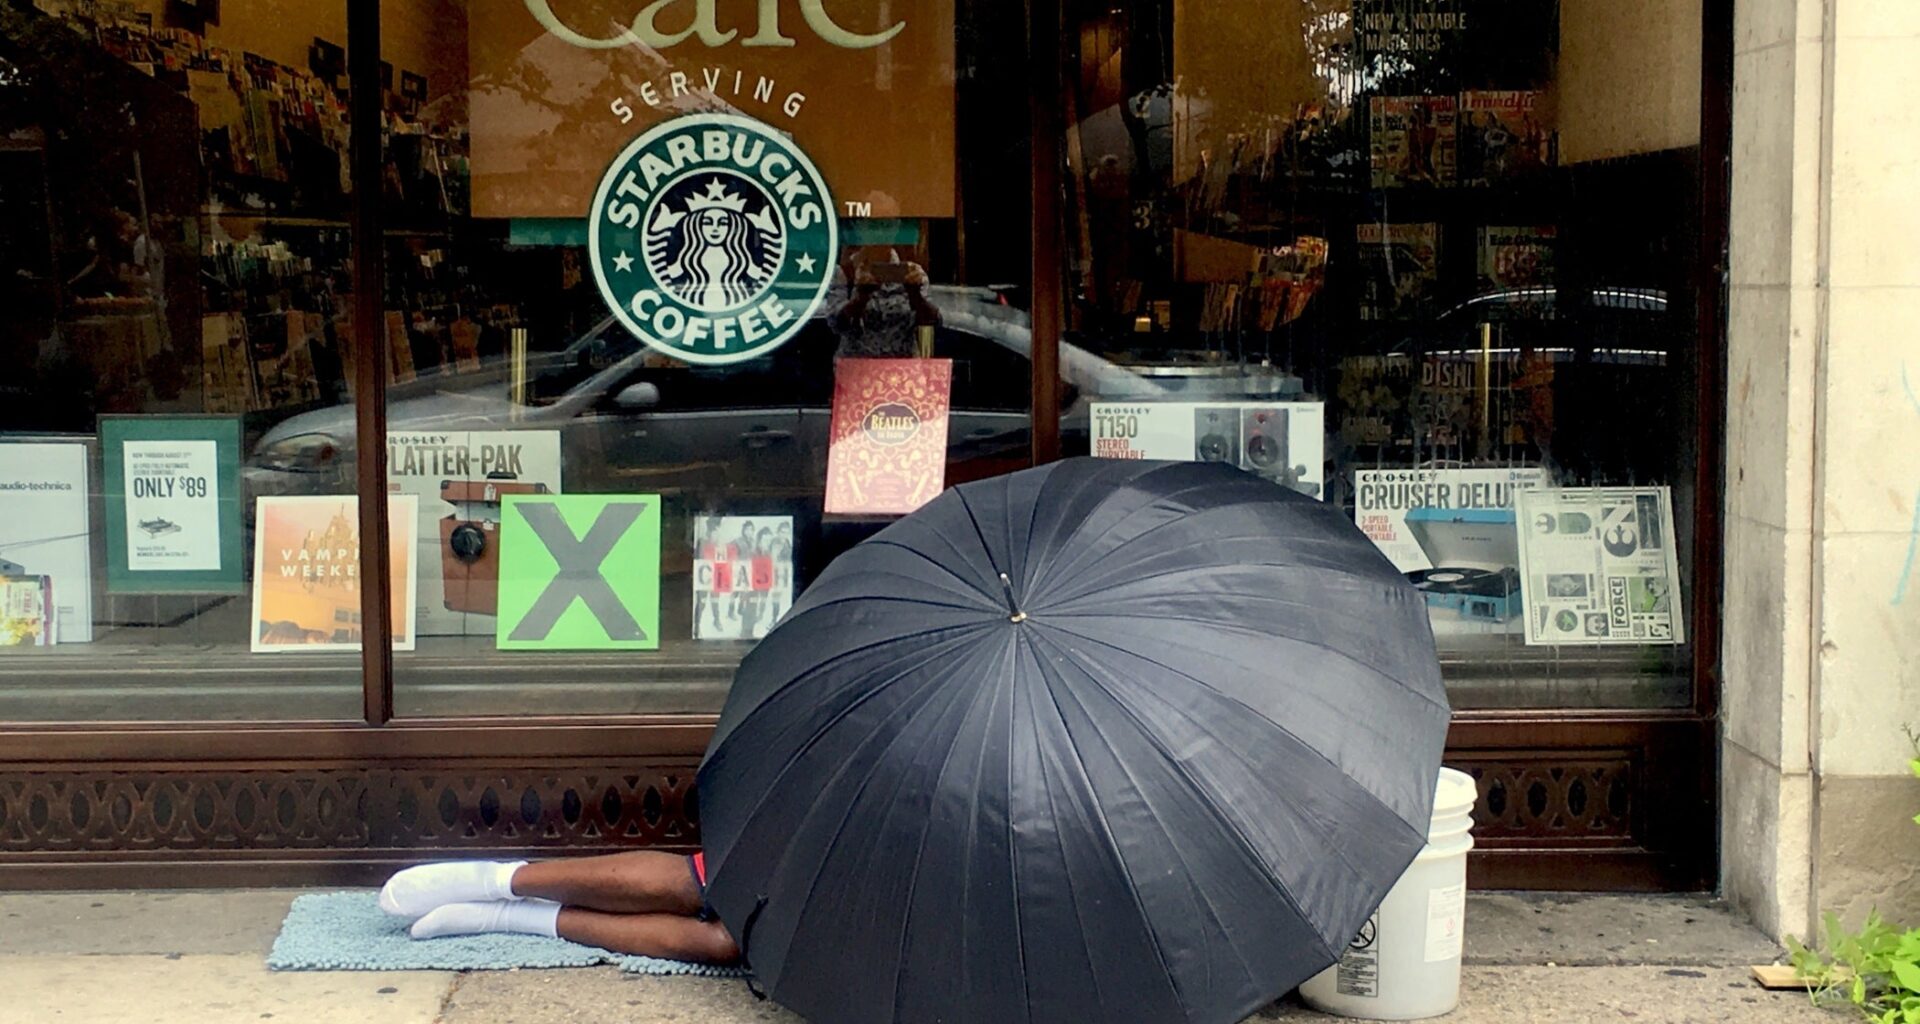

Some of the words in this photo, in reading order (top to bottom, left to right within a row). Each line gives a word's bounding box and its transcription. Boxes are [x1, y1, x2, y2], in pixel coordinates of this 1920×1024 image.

[1365, 13, 1394, 30] NEW
[1412, 12, 1467, 30] NOTABLE
[610, 67, 806, 124] SERVING
[607, 130, 823, 230] STARBUCKS
[846, 202, 871, 216] TM
[631, 290, 793, 349] COFFEE
[871, 415, 914, 430] BEATLES
[1096, 407, 1151, 415] CROSLEY
[1096, 415, 1138, 438] T150
[1096, 438, 1129, 450] STEREO
[387, 445, 523, 476] LATTER-PAK
[0, 480, 72, 490] audio-technica
[133, 477, 175, 498] ONLY
[179, 475, 206, 498] $89
[1362, 473, 1438, 483] CROSLEY
[1360, 483, 1450, 510] CRUISER
[1458, 482, 1535, 509] DELU
[1366, 532, 1397, 541] RNTABLE
[280, 564, 355, 577] WEEKE
[507, 502, 648, 641] X
[697, 563, 790, 590] CLASH
[1612, 579, 1626, 624] FORCE
